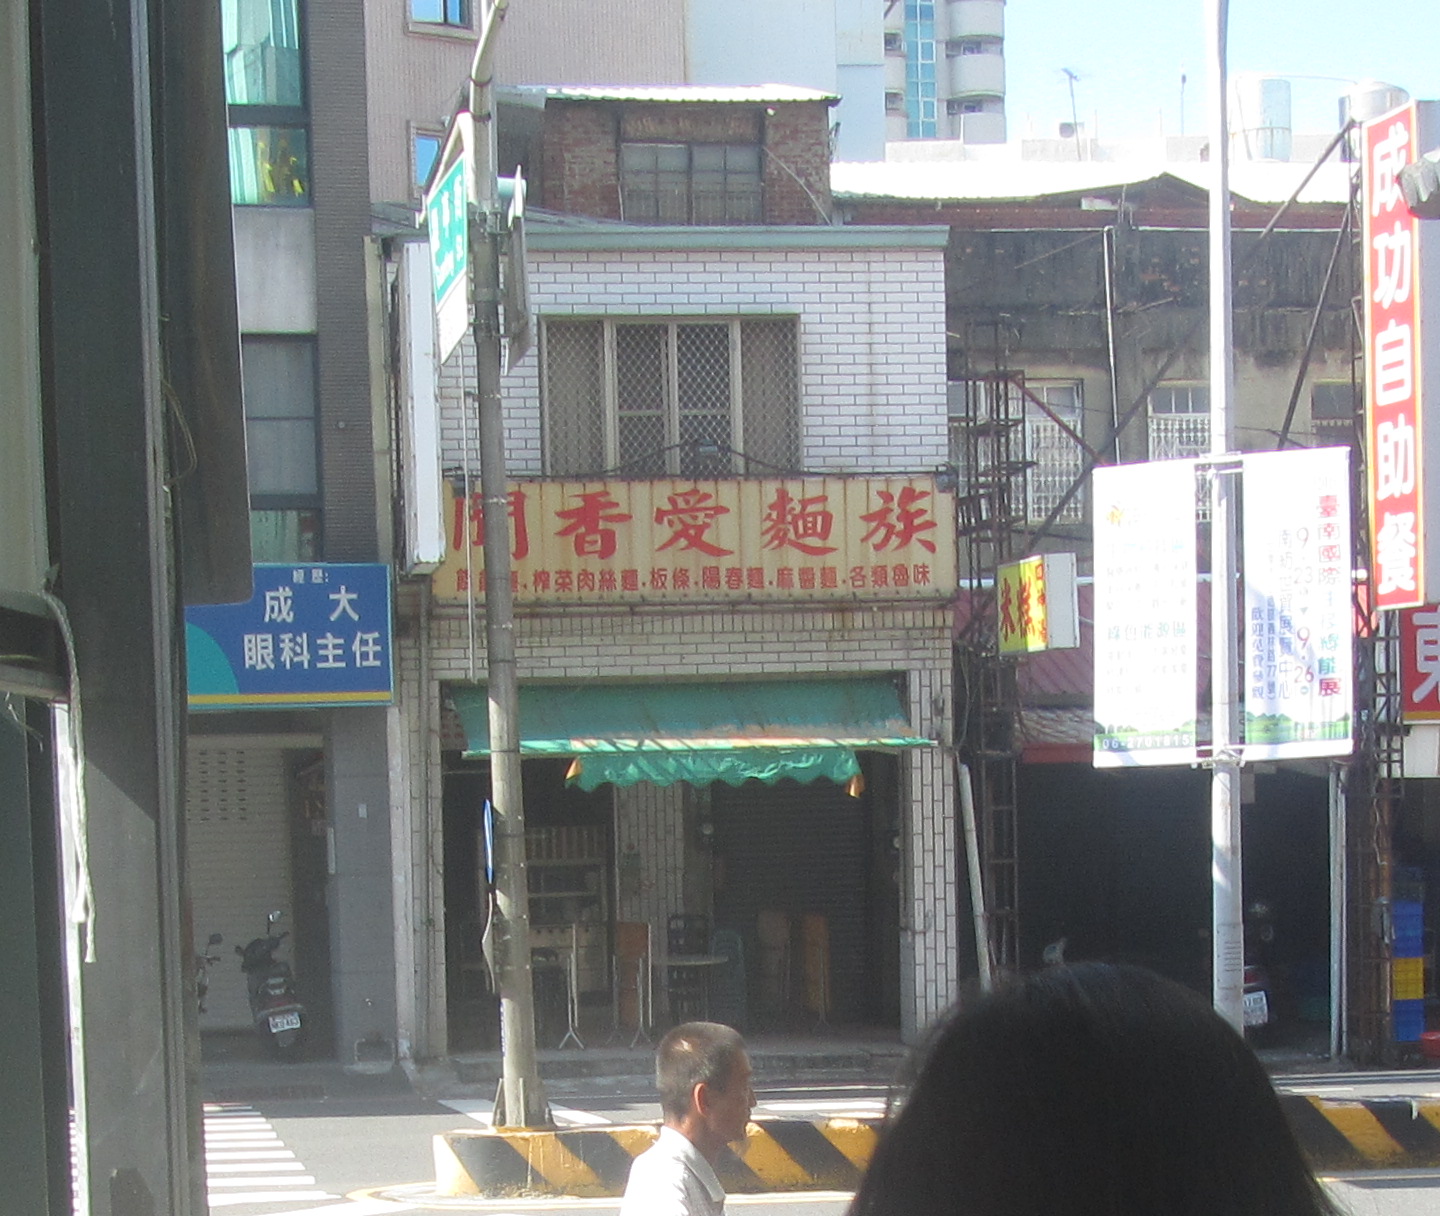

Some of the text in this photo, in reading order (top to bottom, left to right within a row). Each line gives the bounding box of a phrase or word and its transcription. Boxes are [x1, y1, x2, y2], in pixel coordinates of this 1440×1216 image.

[1371, 121, 1416, 596] 成功自助餐
[244, 632, 382, 670] 眼科主任
